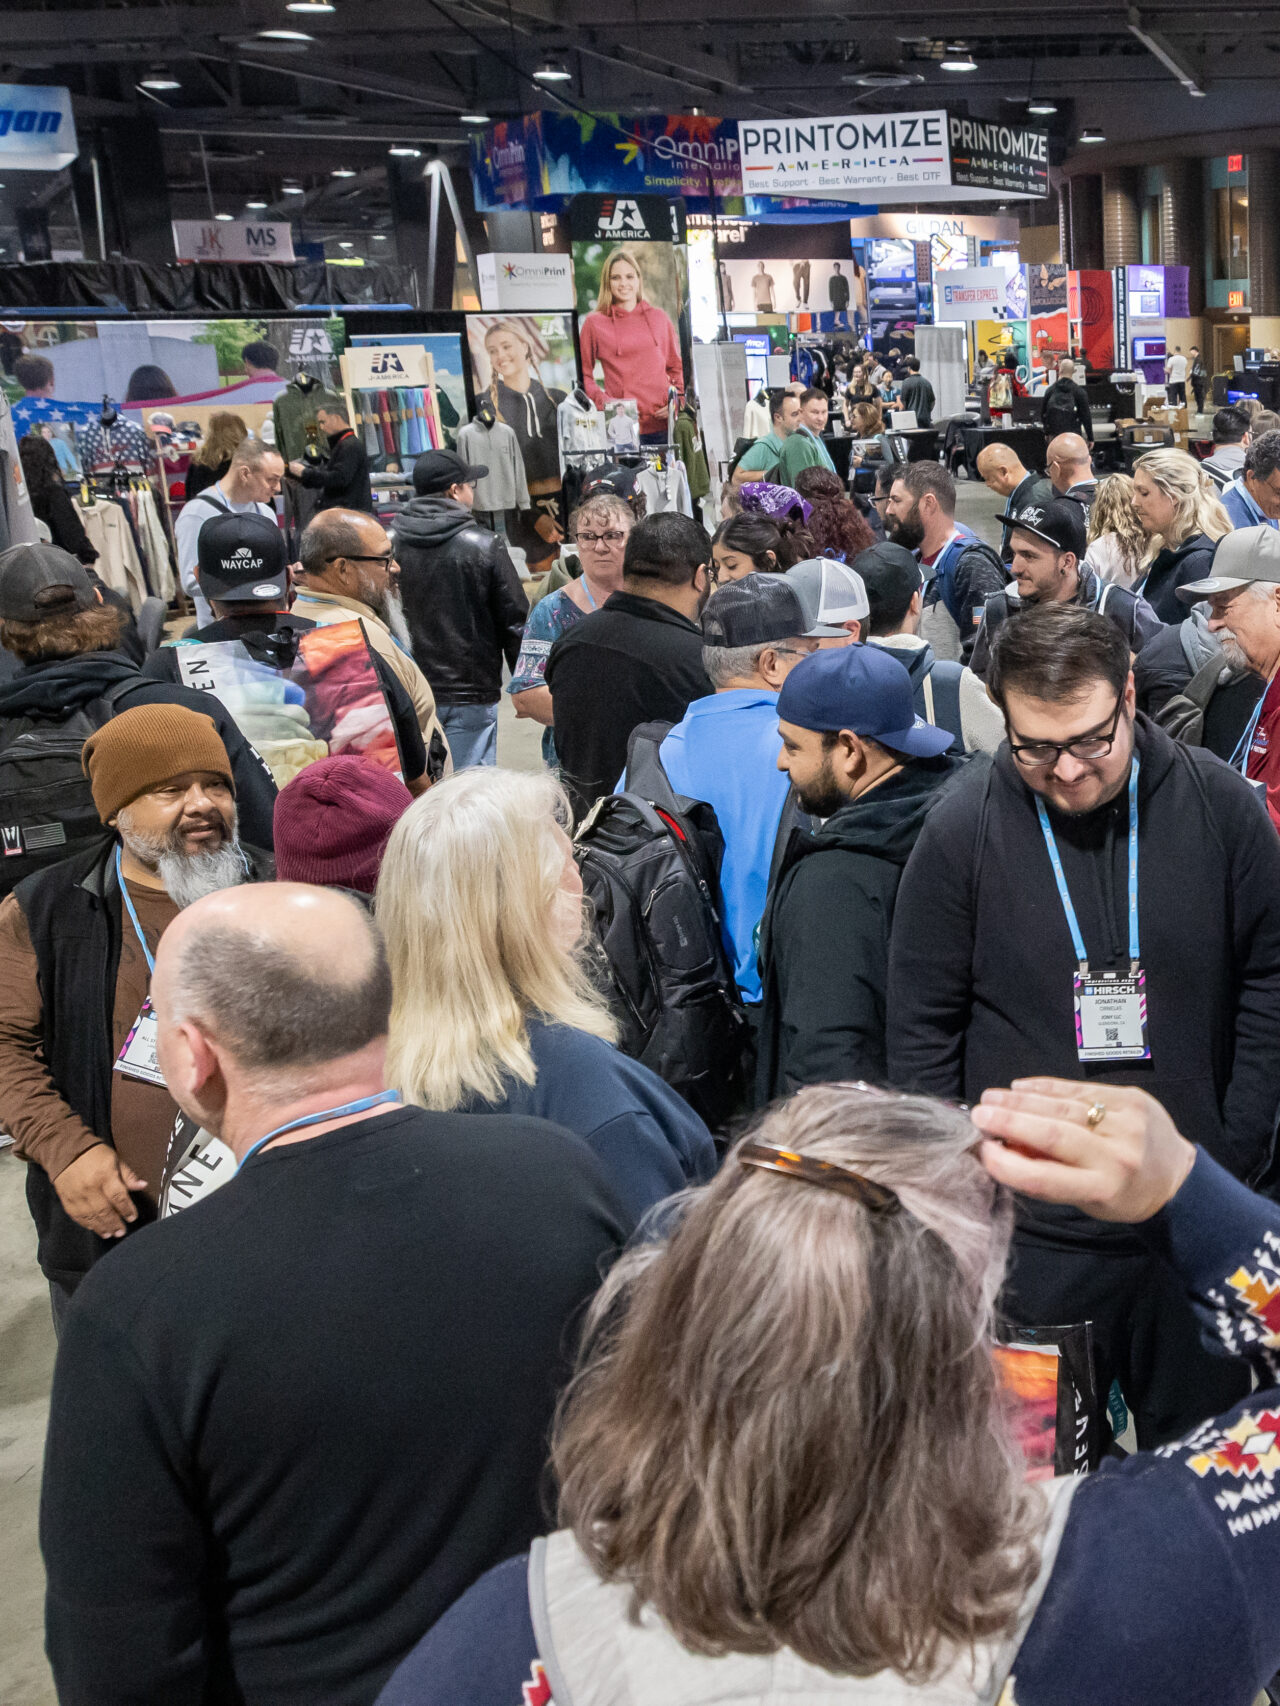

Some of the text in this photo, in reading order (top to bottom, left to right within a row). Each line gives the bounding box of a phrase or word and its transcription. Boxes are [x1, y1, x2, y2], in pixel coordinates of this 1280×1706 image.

[743, 117, 942, 155] PRINTOMIZE
[950, 118, 1047, 162] PRINTOMIZE
[1228, 155, 1242, 171] EXIT
[748, 172, 941, 188] Best Support Best Warranty Best DTF
[605, 230, 650, 239] AMERICA
[1229, 291, 1243, 306] EXIT
[221, 559, 263, 569] WAYCAP
[1094, 986, 1136, 995] HIRSCH
